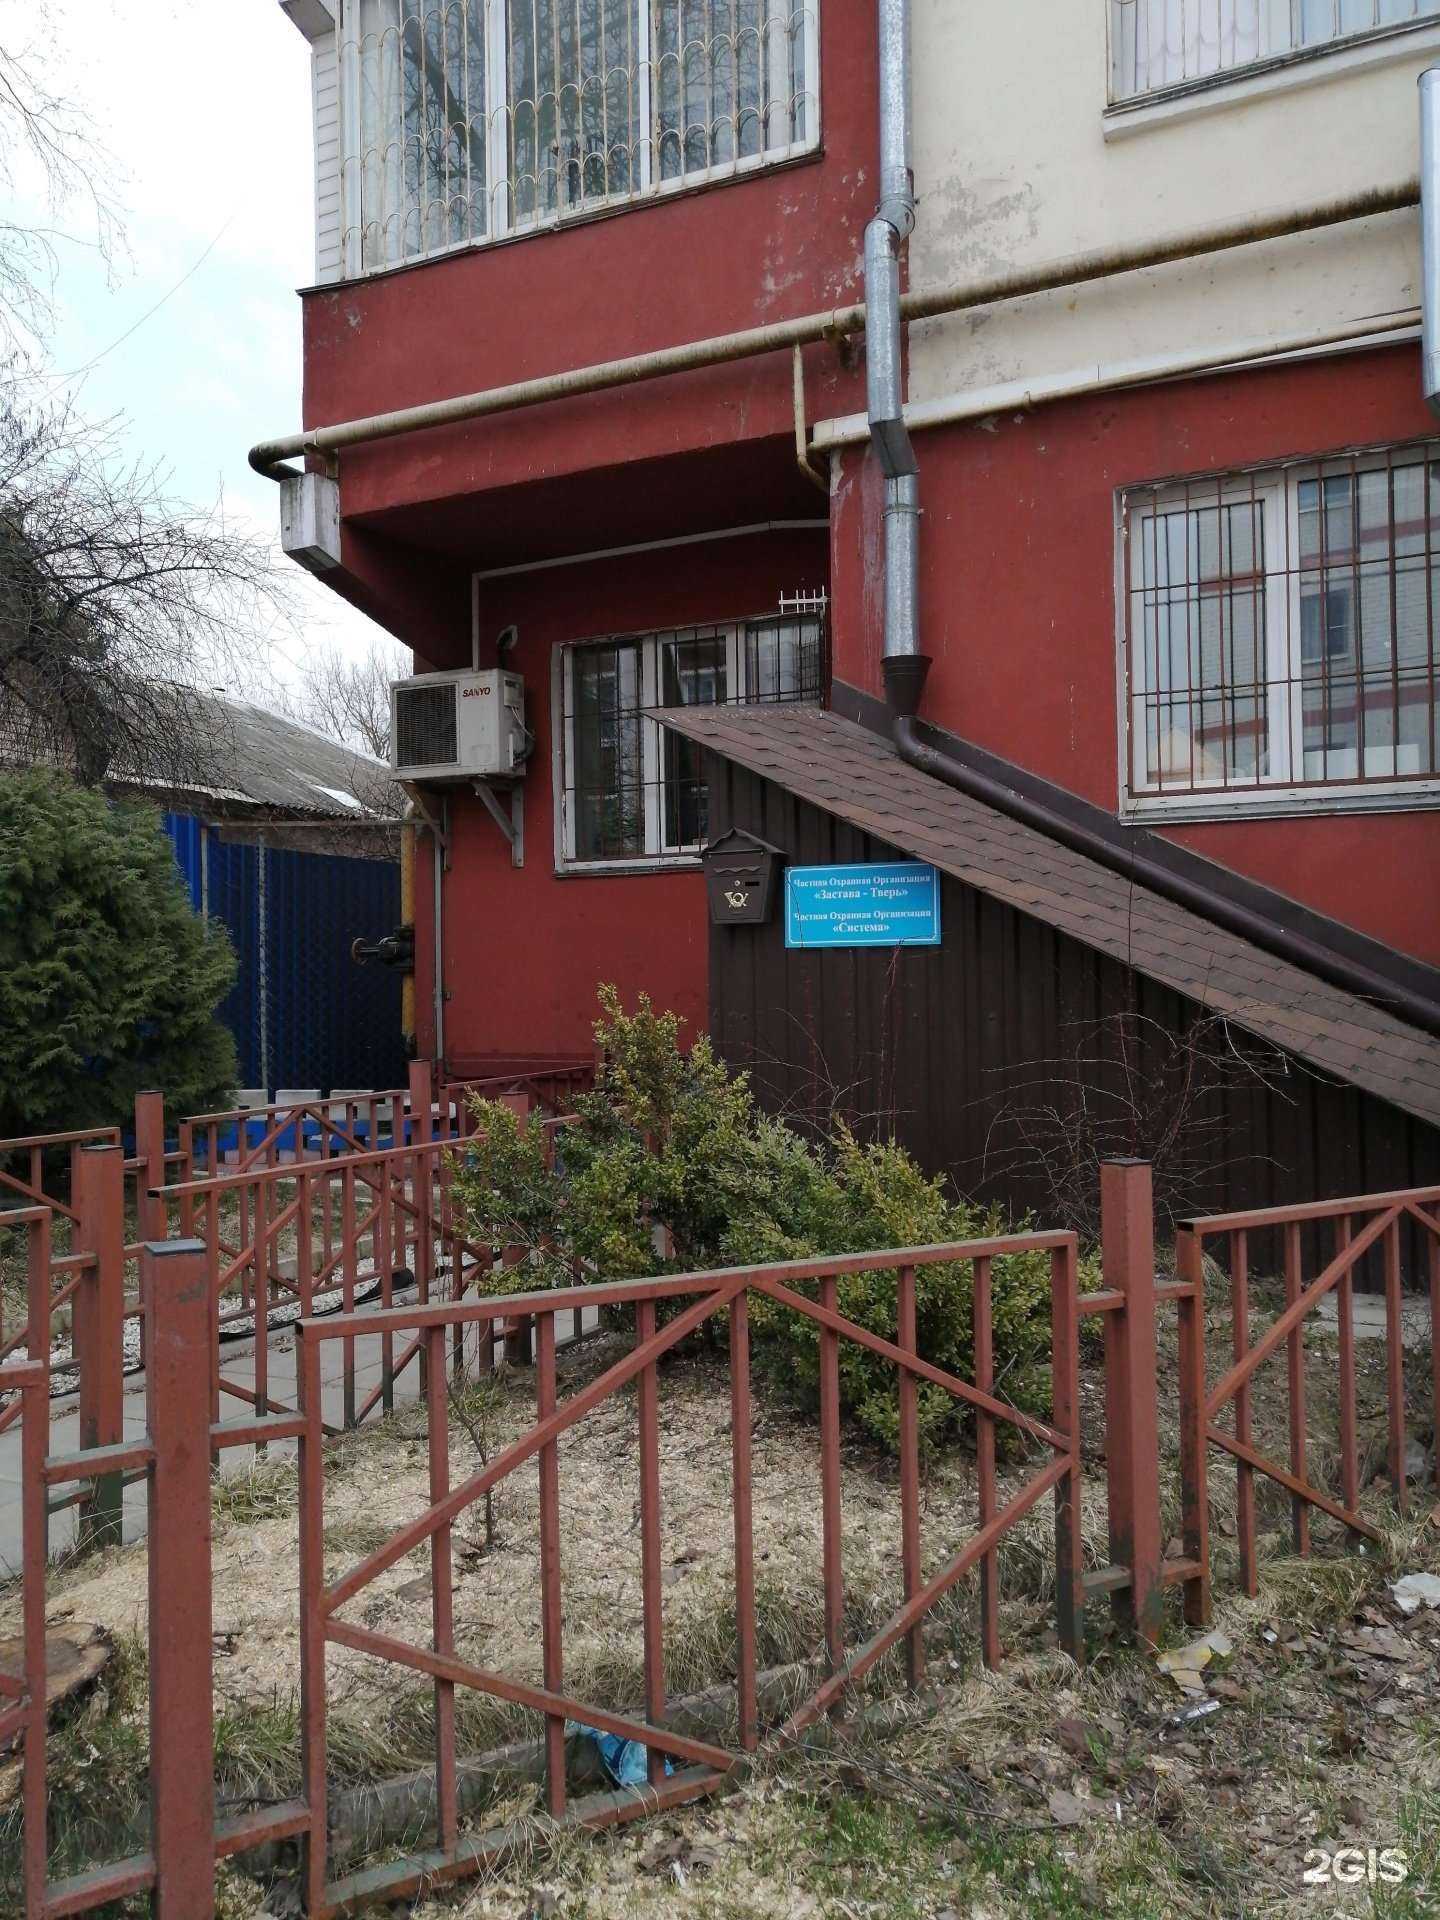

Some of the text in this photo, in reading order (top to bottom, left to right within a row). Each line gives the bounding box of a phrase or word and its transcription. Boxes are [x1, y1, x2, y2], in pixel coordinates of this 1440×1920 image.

[463, 687, 490, 697] SANYO
[794, 875, 931, 888] Частная Охранная Организация
[814, 888, 861, 899] «Застава
[870, 887, 909, 899] Тверь»
[794, 912, 828, 921] Частная
[830, 912, 872, 921] Охранная
[833, 922, 890, 932] «Система»
